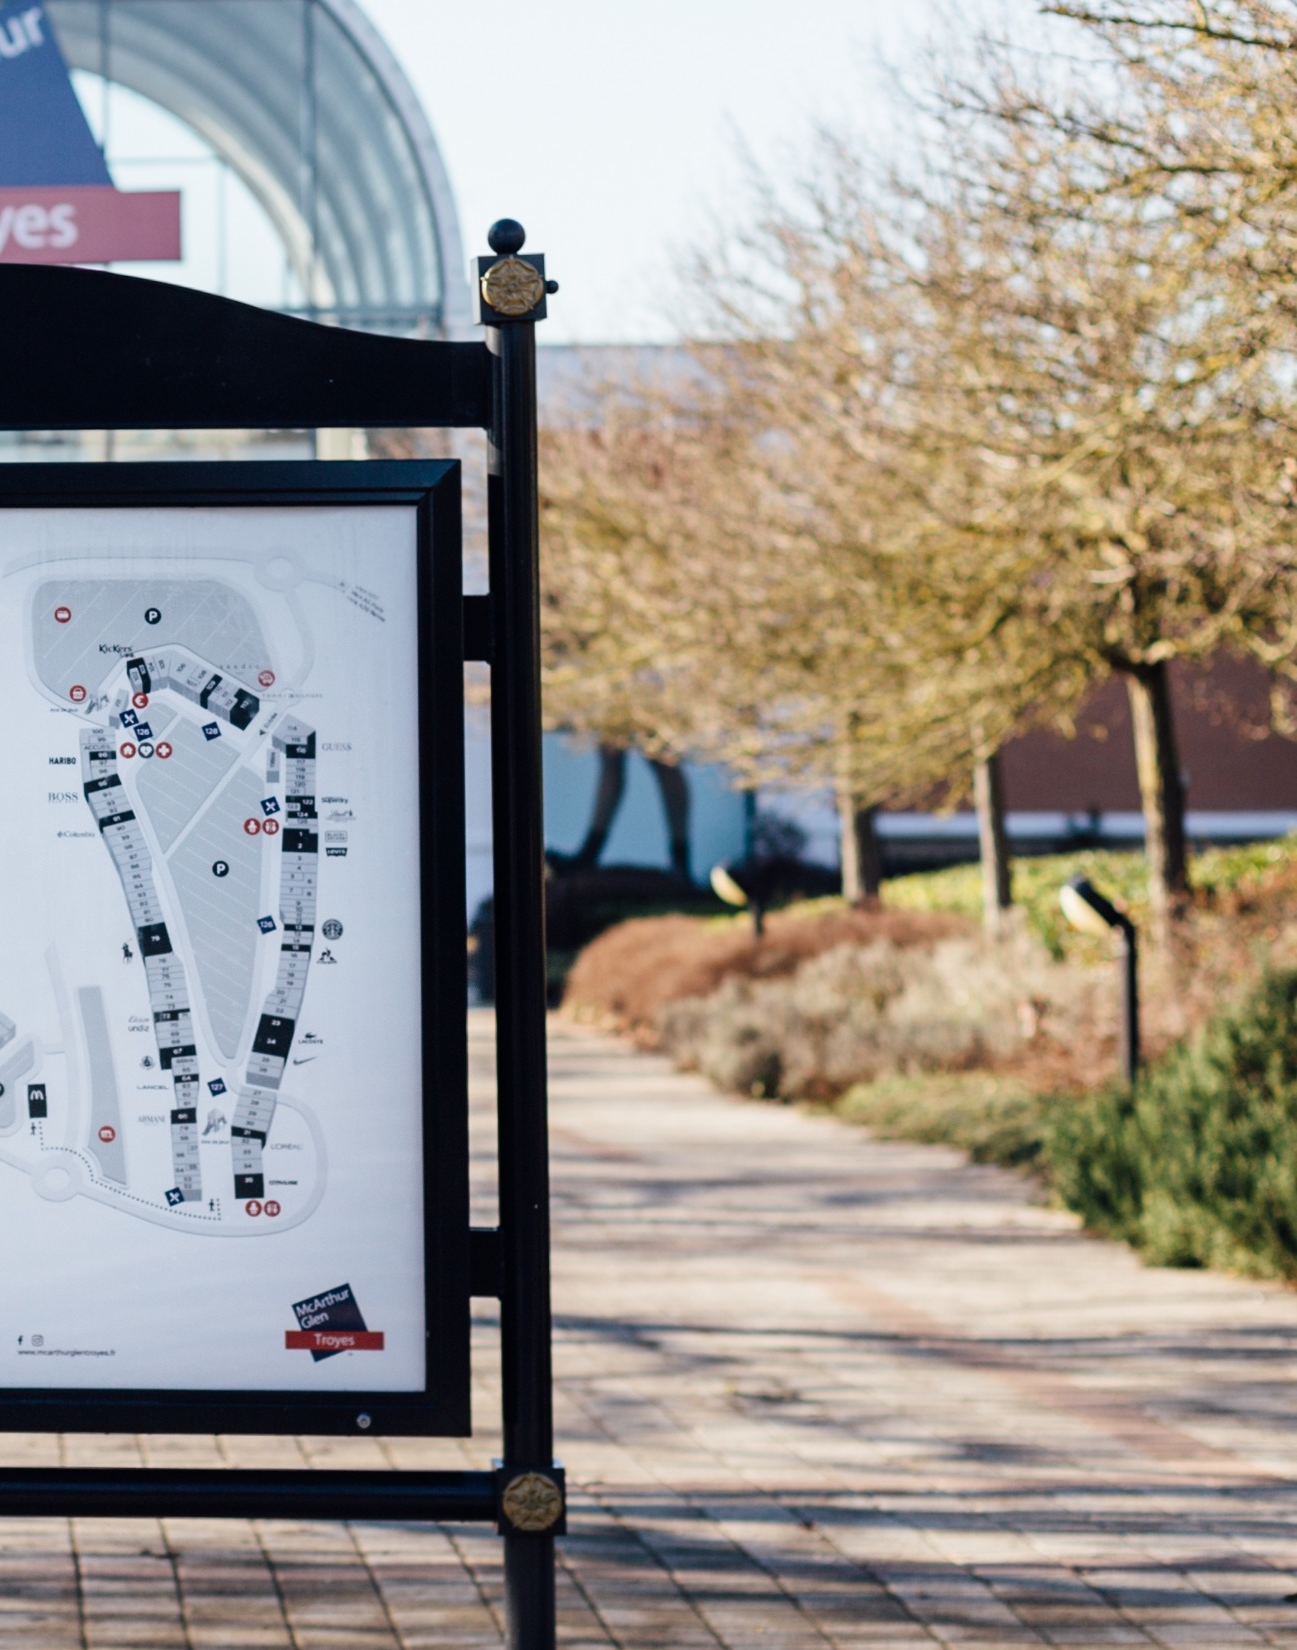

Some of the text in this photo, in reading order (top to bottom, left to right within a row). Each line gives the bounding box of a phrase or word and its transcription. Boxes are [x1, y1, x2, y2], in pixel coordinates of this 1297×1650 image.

[322, 743, 352, 751] GUESS
[49, 757, 76, 765] HARIBO
[48, 792, 78, 800] BOSS
[295, 1289, 350, 1317] McArthur
[301, 1312, 329, 1328] Glen
[314, 1333, 355, 1348] Troyes
